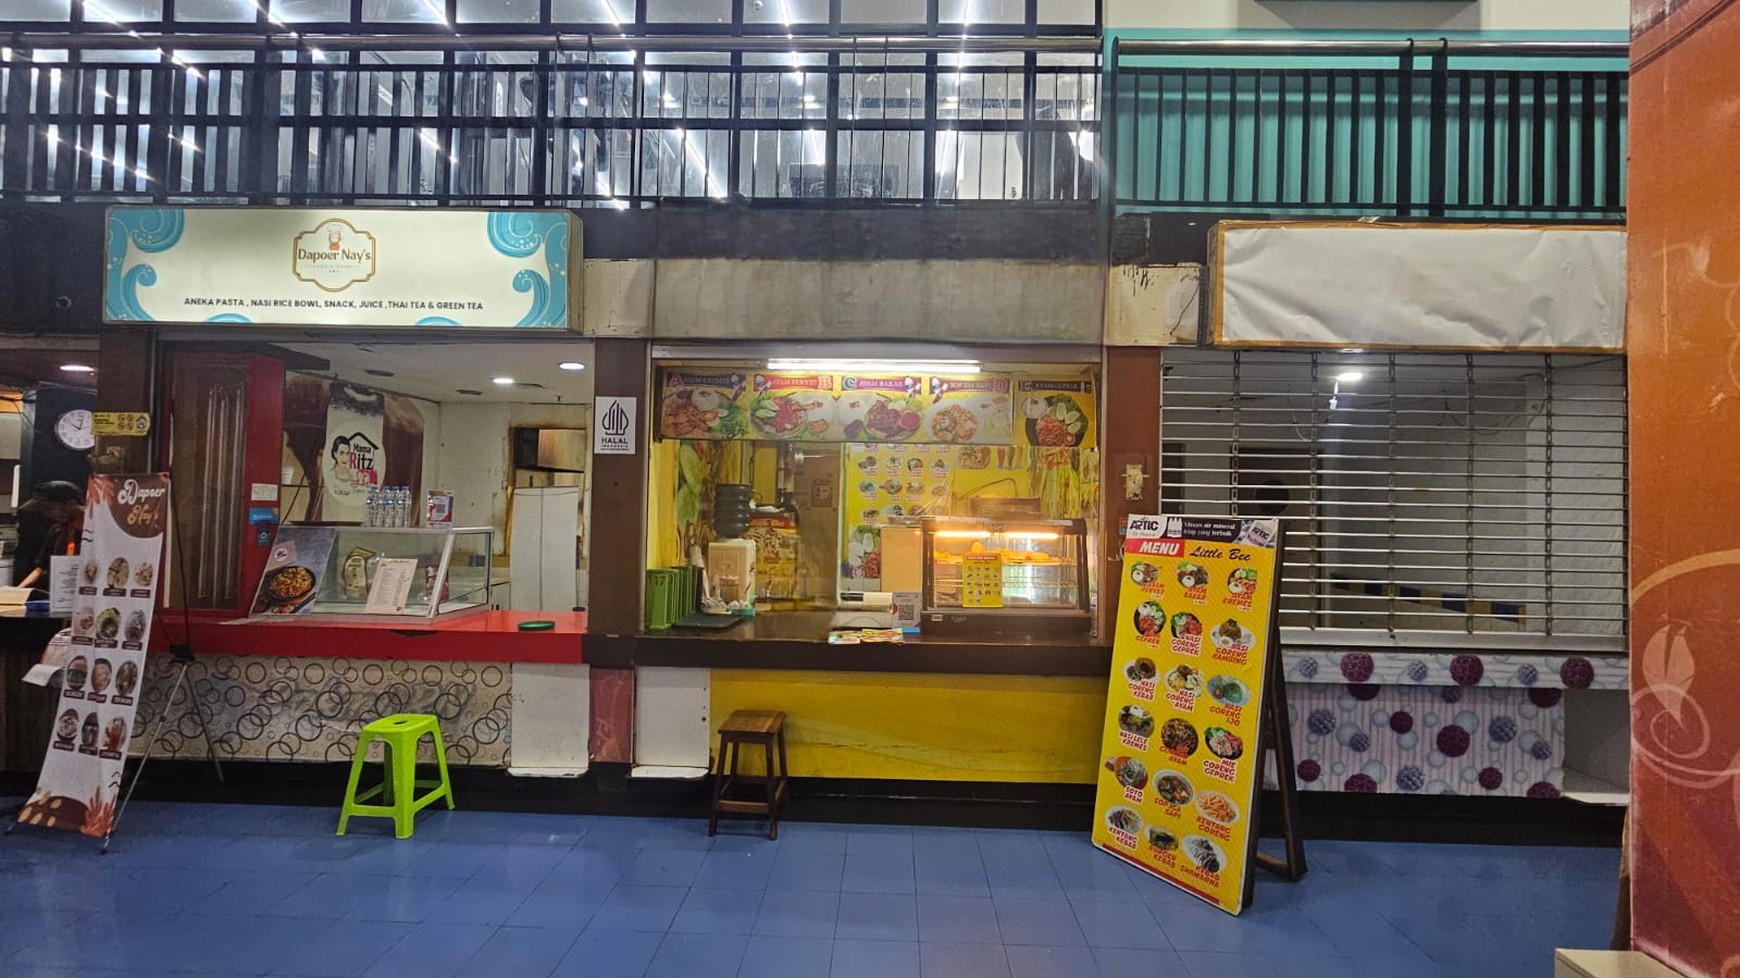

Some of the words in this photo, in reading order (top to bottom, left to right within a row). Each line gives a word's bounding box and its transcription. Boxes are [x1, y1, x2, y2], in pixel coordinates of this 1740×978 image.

[298, 248, 340, 263] Dapoer
[341, 249, 371, 264] Nay's
[184, 298, 214, 306] ANEKA
[216, 298, 244, 306] PASTA
[250, 299, 272, 307] NASI
[273, 299, 293, 307] RICE
[294, 300, 322, 308] BOWL,
[324, 300, 357, 309] SNACK,
[358, 301, 383, 309] JUICE
[436, 302, 465, 310] GREEN
[353, 443, 371, 454] Mama
[349, 452, 374, 470] Ritz
[117, 478, 166, 506] Dapoer
[1130, 520, 1159, 531] ARTIC
[1251, 526, 1270, 539] ARTIC
[1139, 541, 1181, 555] MENU
[1189, 546, 1224, 559] Little
[1229, 548, 1251, 561] Bee
[1171, 639, 1200, 649] GORENG
[1172, 646, 1199, 655] GEPREK
[1215, 647, 1248, 659] GORENG
[1128, 683, 1154, 695] GORENG
[1140, 680, 1155, 688] NASI
[1165, 693, 1194, 705] GORENG
[1179, 689, 1196, 699] NASI
[1174, 701, 1193, 712] AYAM
[1209, 706, 1242, 719] GORENG
[1224, 702, 1242, 712] NASI
[1226, 718, 1241, 726] IJO
[1203, 760, 1235, 775] GORENG
[1221, 759, 1236, 768] MIE
[1204, 767, 1235, 782] GEPREK
[1124, 792, 1142, 803] AYAM
[1126, 786, 1143, 797] SOTO
[1109, 827, 1138, 843] KENTANG
[1198, 825, 1230, 841] GORENG
